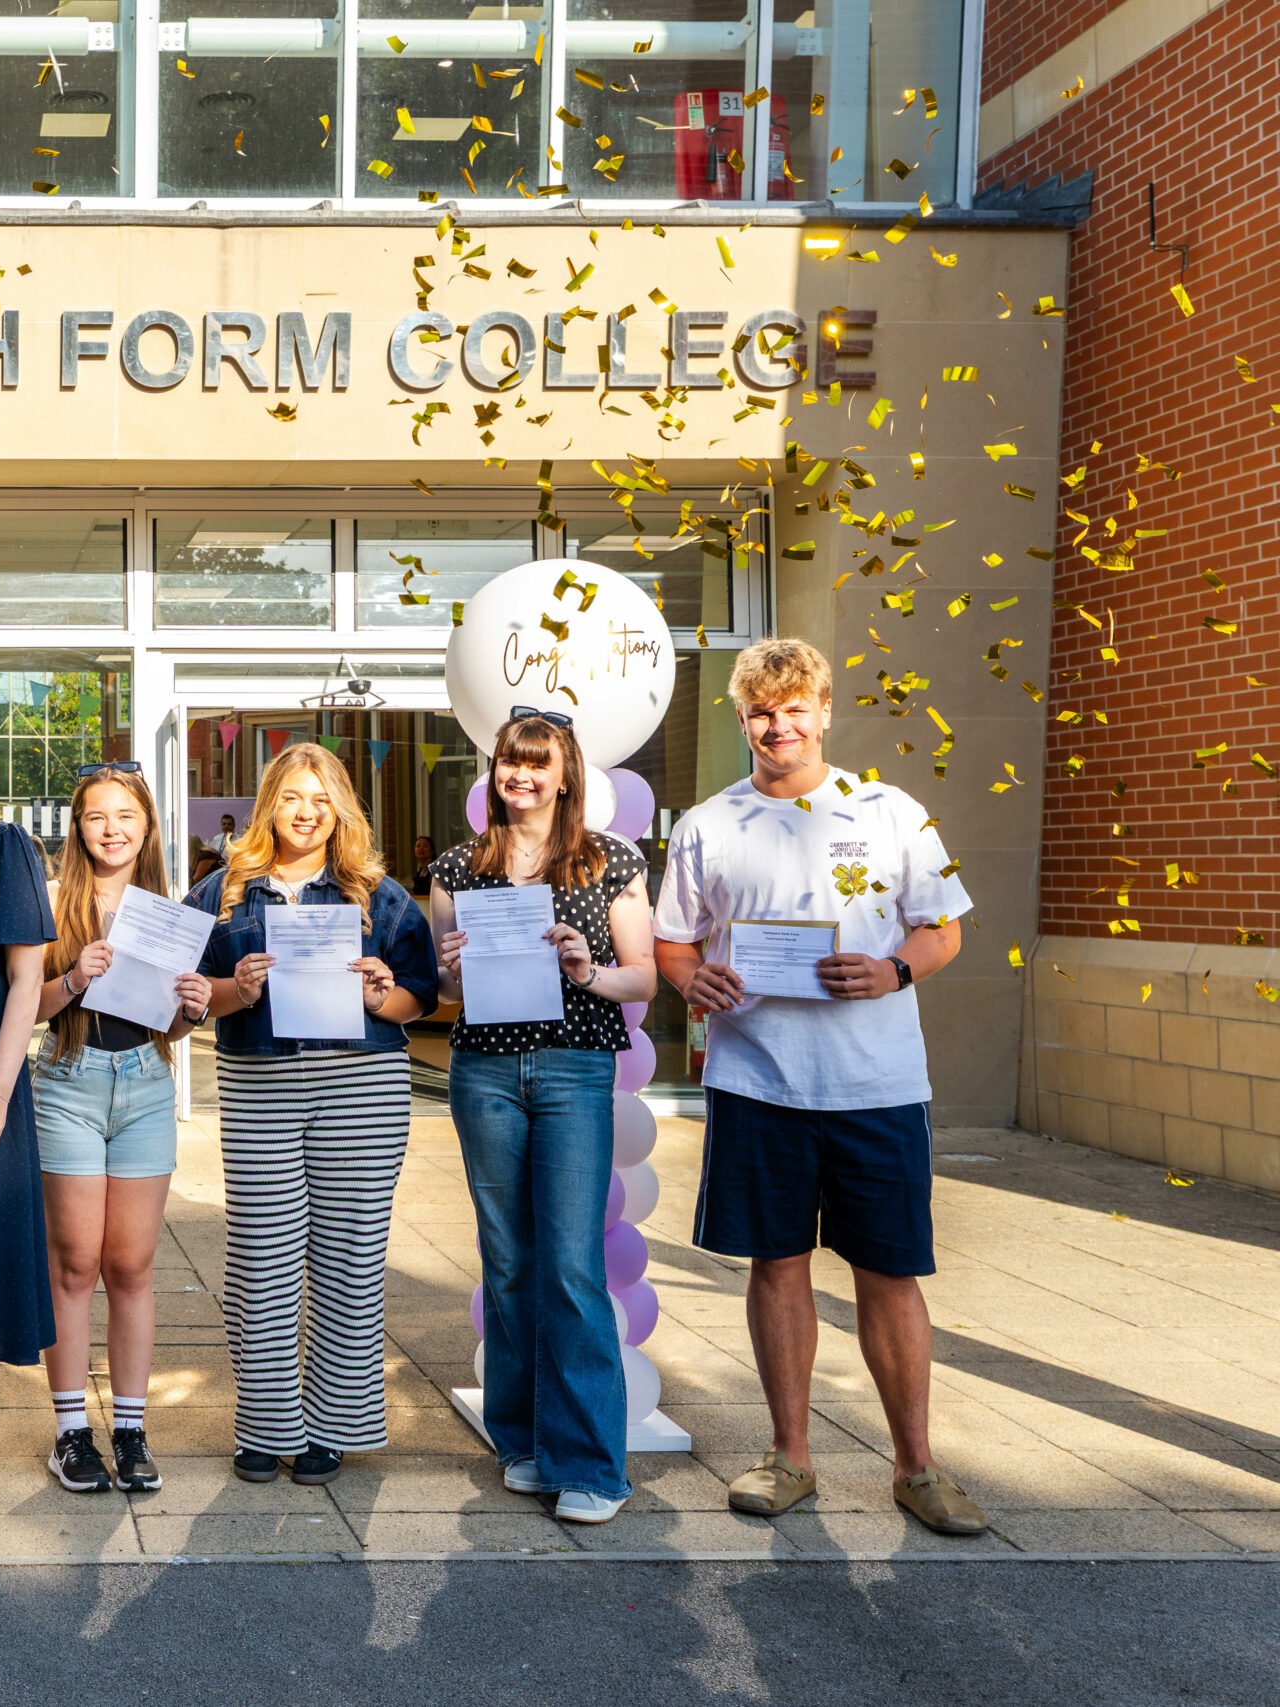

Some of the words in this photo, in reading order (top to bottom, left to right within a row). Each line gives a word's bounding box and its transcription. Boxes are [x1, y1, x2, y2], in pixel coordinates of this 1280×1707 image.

[722, 96, 741, 110] 31
[60, 310, 353, 393] FORM
[388, 310, 878, 393] COLLEGE
[503, 620, 661, 693] Conglations
